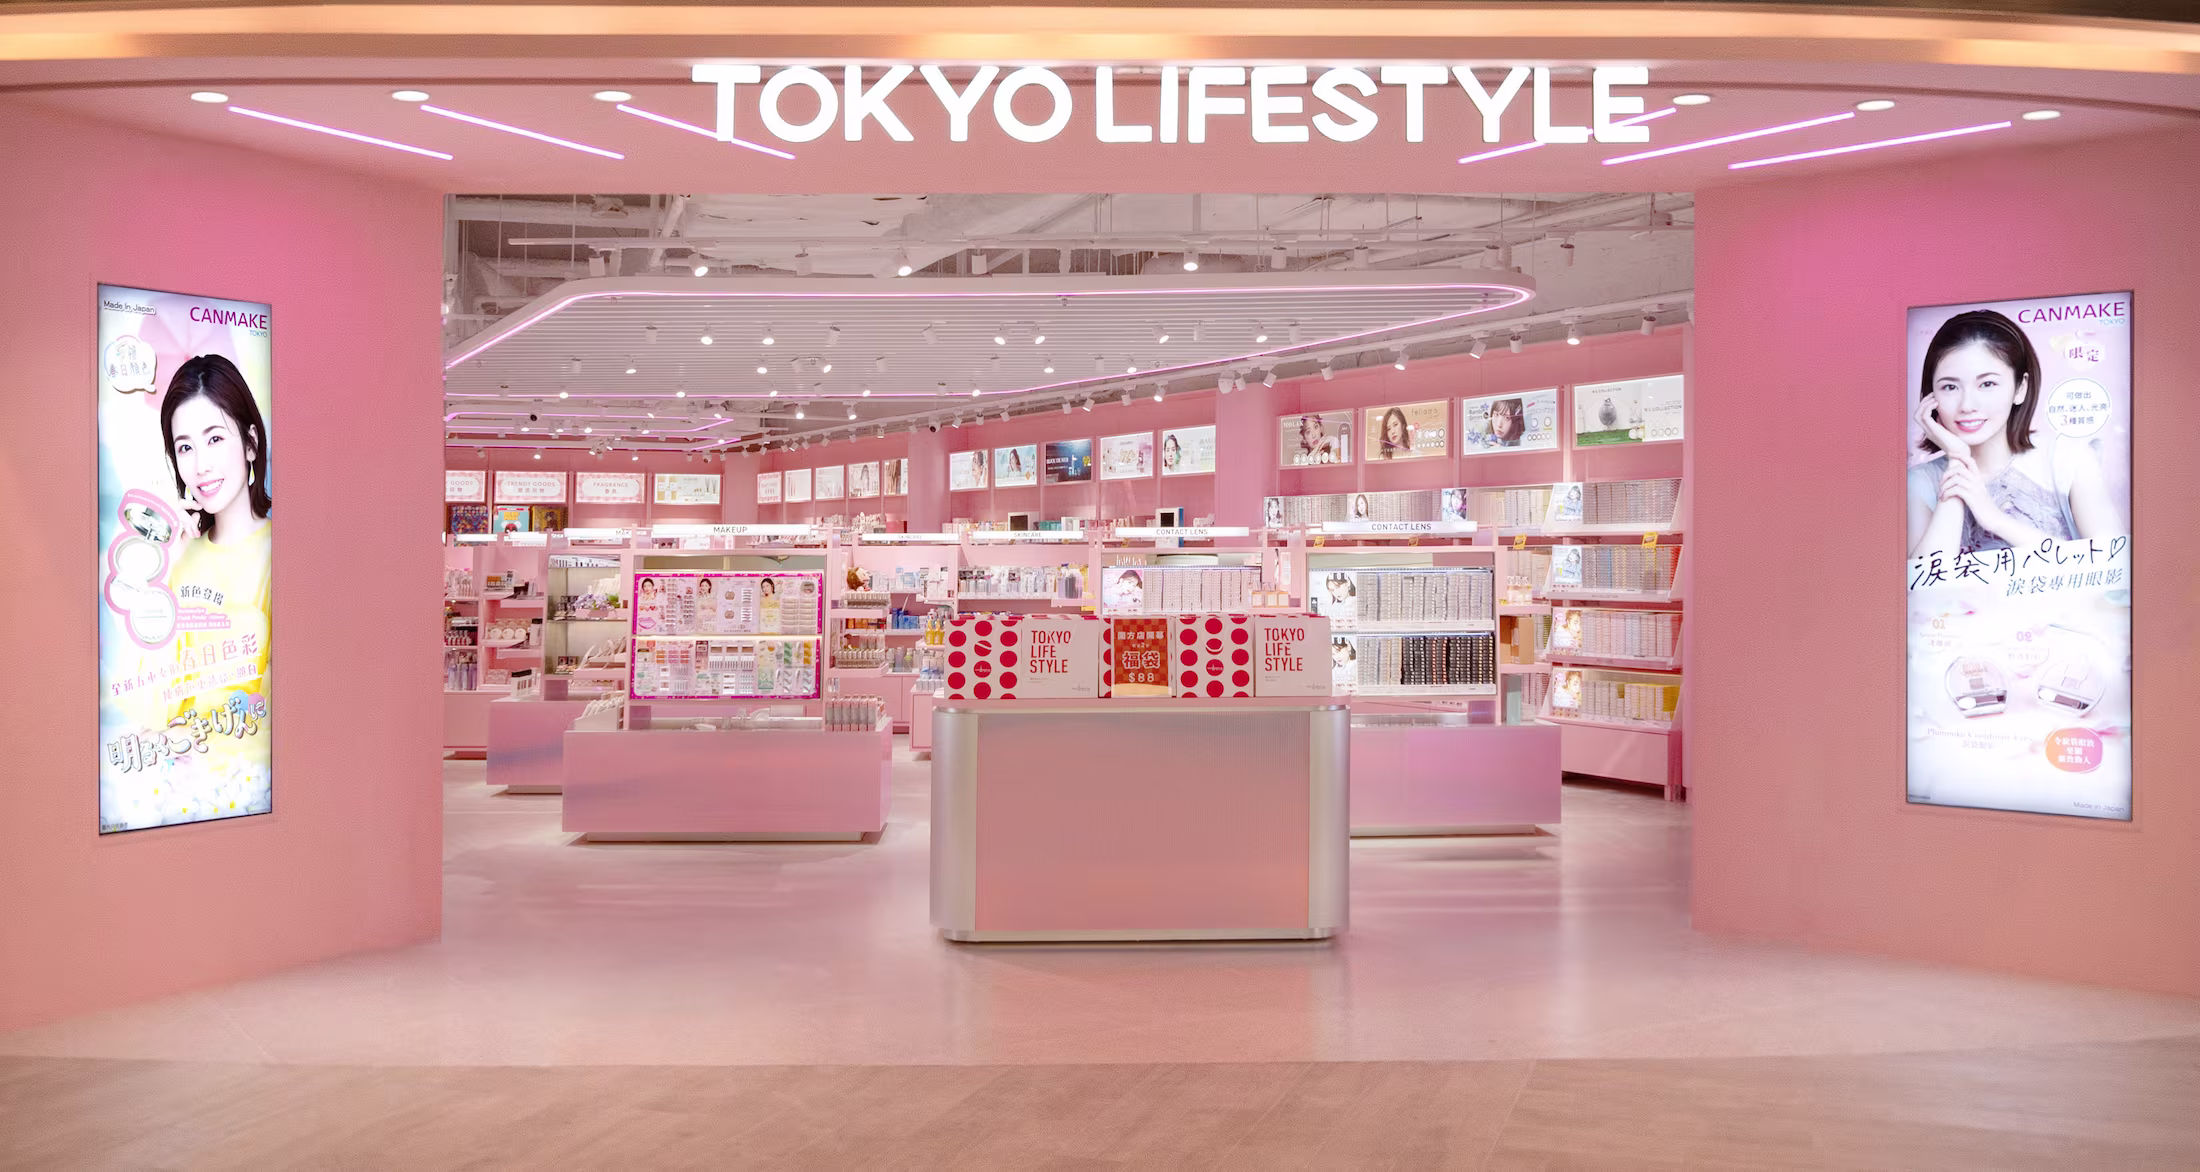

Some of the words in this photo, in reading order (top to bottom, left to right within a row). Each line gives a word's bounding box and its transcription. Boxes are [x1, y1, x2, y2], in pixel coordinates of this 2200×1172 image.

[692, 65, 1072, 143] TOKYO
[1096, 65, 1650, 143] LIFESTYLE
[104, 300, 123, 310] Made
[132, 305, 155, 314] Japan
[2018, 301, 2125, 324] CANMAKE
[190, 306, 268, 330] CANMAKE
[2099, 318, 2125, 326] TOKYO
[249, 330, 268, 338] TOKYO
[2068, 347, 2100, 362] 限定
[713, 526, 748, 534] MAKEUP
[1372, 523, 1409, 531] CONTACT
[1410, 523, 1432, 531] LENS
[1931, 618, 1946, 630] 01
[1031, 630, 1071, 644] TOKYO
[1264, 628, 1305, 641] TOKYO
[2016, 632, 2033, 643] 02
[1030, 645, 1057, 658] LIFE
[1264, 642, 1292, 656] LIFE
[1030, 659, 1069, 674] STYLE
[1122, 651, 1161, 669] 福袋
[1264, 657, 1304, 672] STYLE
[1128, 672, 1155, 683] $88
[2073, 801, 2092, 809] Made
[2102, 804, 2125, 812] Japan
